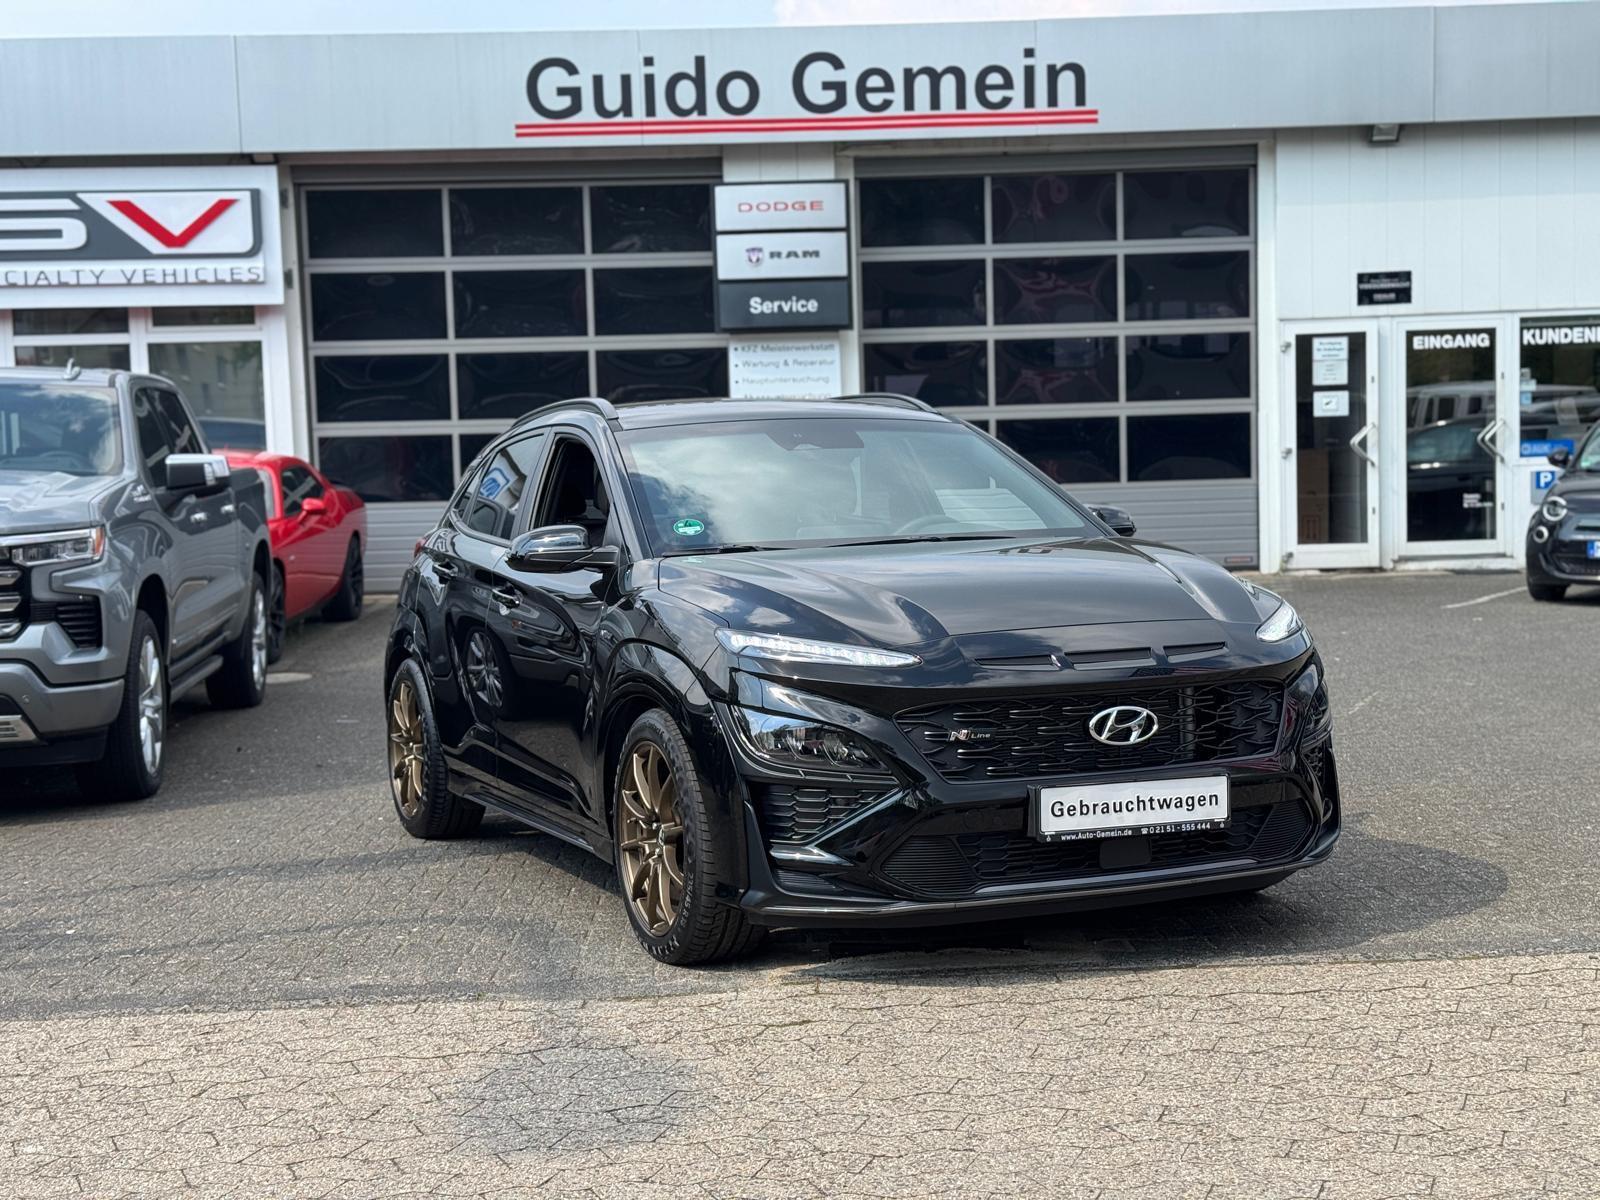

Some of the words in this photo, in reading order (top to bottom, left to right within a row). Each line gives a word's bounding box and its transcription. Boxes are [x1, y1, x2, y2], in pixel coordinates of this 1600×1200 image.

[525, 55, 760, 120] Guido
[791, 48, 1087, 114] Gemein
[738, 200, 824, 213] DODGE
[769, 249, 821, 260] RAM
[120, 265, 261, 285] VEHICLES
[748, 295, 818, 314] Service
[1412, 333, 1491, 350] EINGANG
[1522, 325, 1600, 346] KUNDEN
[1050, 793, 1219, 818] Gebrauchtwagen
[1061, 828, 1133, 841] www.Auto-Gemein.de
